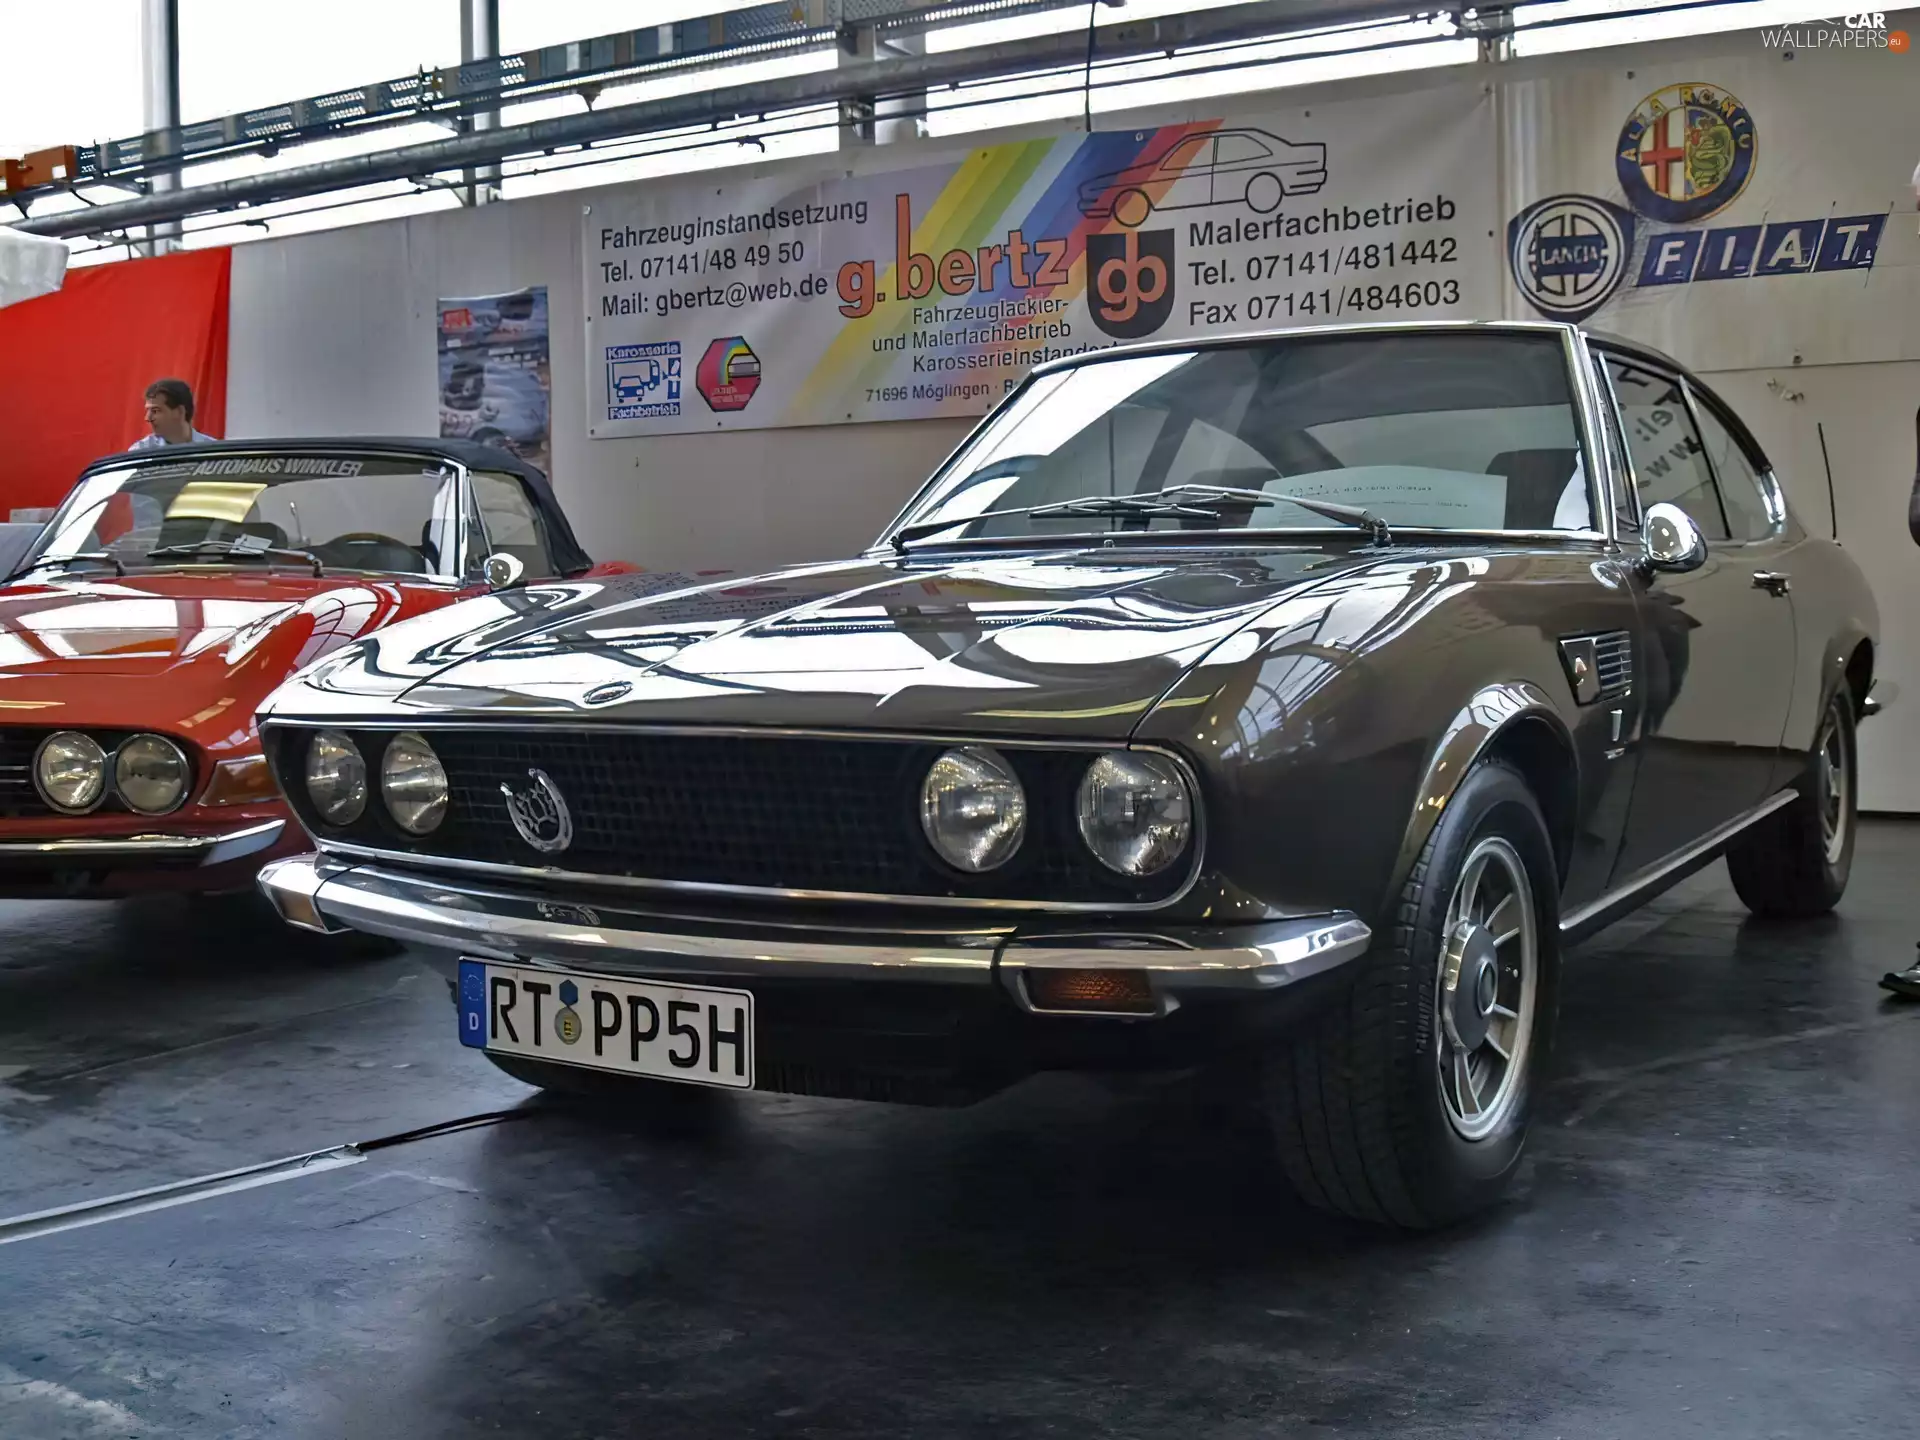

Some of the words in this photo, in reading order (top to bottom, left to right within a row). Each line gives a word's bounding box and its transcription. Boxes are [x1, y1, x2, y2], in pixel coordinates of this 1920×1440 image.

[601, 199, 868, 250] Fahrzeuginstandsetzung
[1189, 195, 1456, 247] Malerfachbetrieb
[601, 261, 634, 284] Tel.
[640, 249, 738, 281] 07141/48
[743, 246, 770, 268] 49
[777, 241, 805, 263] 50
[836, 194, 1069, 319] g.bertz
[1188, 260, 1236, 286] Tel.
[1246, 237, 1458, 282] 07141/481442
[1540, 245, 1599, 265] LANCIA
[1655, 224, 1870, 277] FIAT
[602, 293, 649, 317] Mail:
[655, 274, 829, 315] gbertz@web.de
[912, 297, 1070, 325] Fahrzeuglackier-
[1189, 298, 1238, 326] Fax
[1246, 279, 1461, 320] 07141/484603
[872, 330, 906, 352] und
[912, 320, 1072, 350] Malerfachbetrieb
[865, 388, 908, 403] 71696
[912, 382, 990, 402] Möglingen
[192, 457, 283, 477] AUTOHAUS
[283, 457, 364, 477] WINKLER
[468, 1012, 479, 1031] D
[490, 976, 551, 1047] RT
